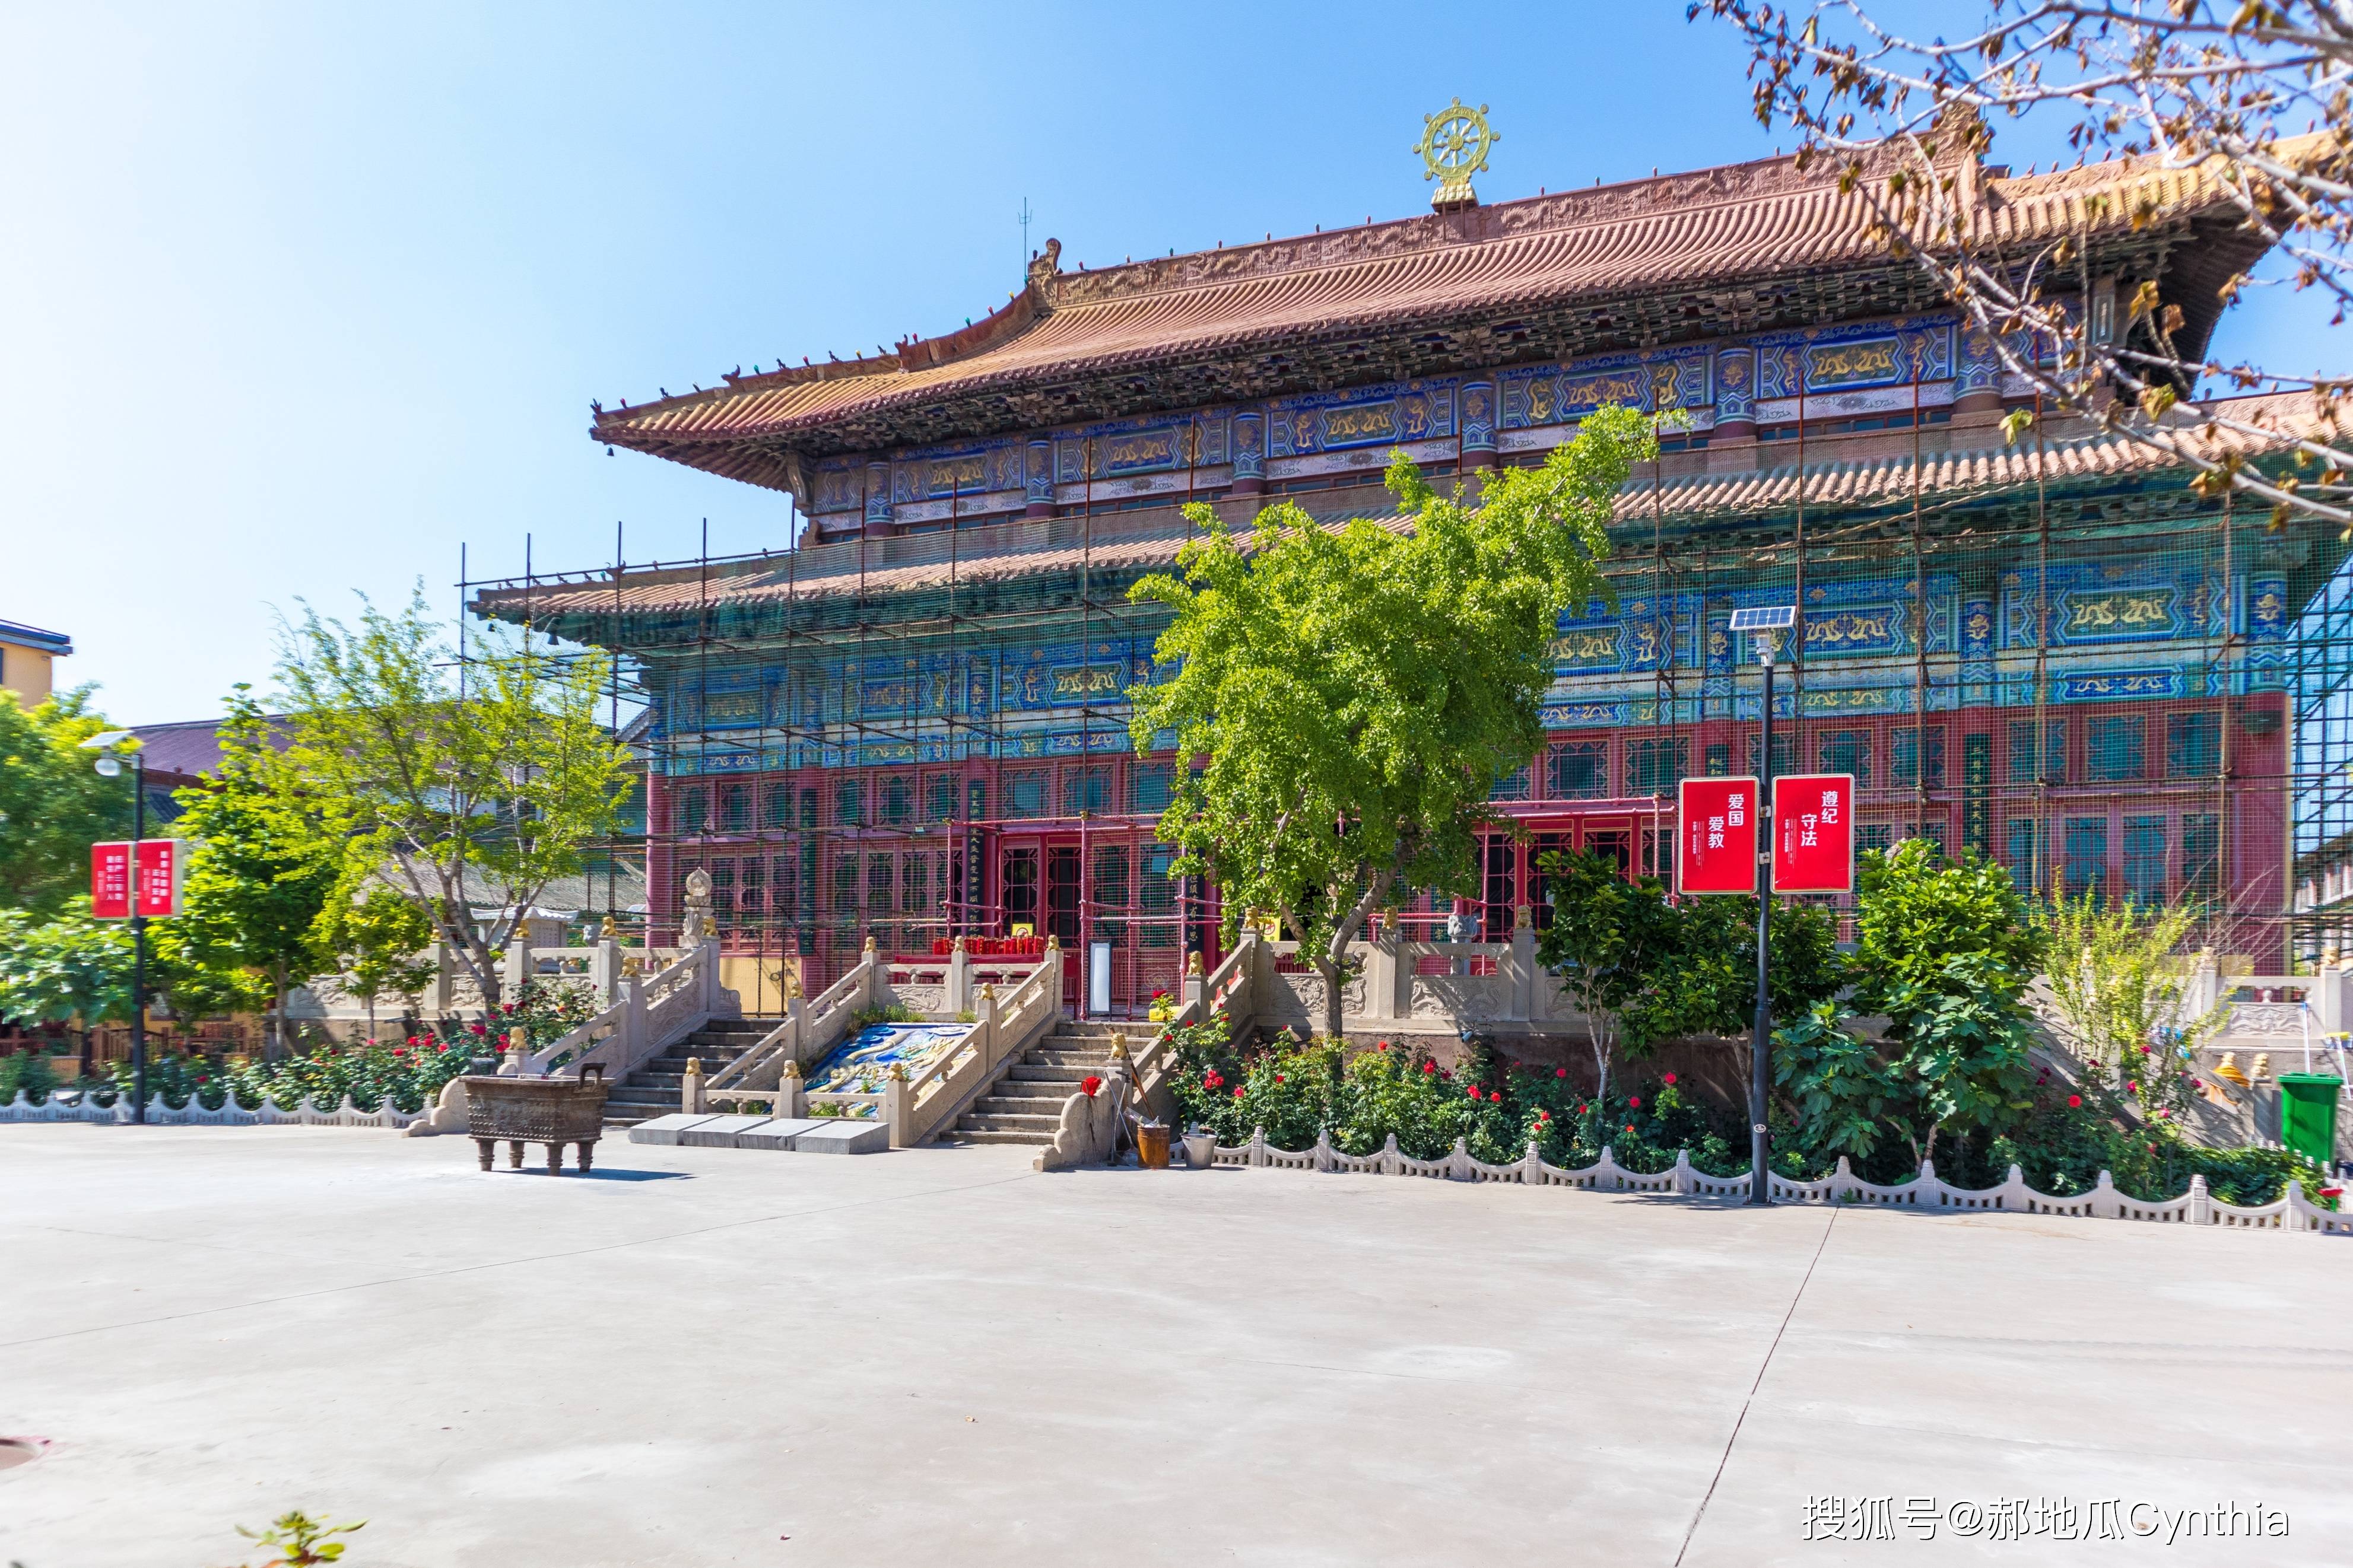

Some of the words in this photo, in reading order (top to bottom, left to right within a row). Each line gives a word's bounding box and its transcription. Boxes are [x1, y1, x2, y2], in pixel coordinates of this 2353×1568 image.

[1728, 793, 1744, 826] 爱国
[1821, 790, 1838, 824] 遵纪
[1708, 816, 1725, 848] 爱教
[1801, 813, 1818, 847] 守法
